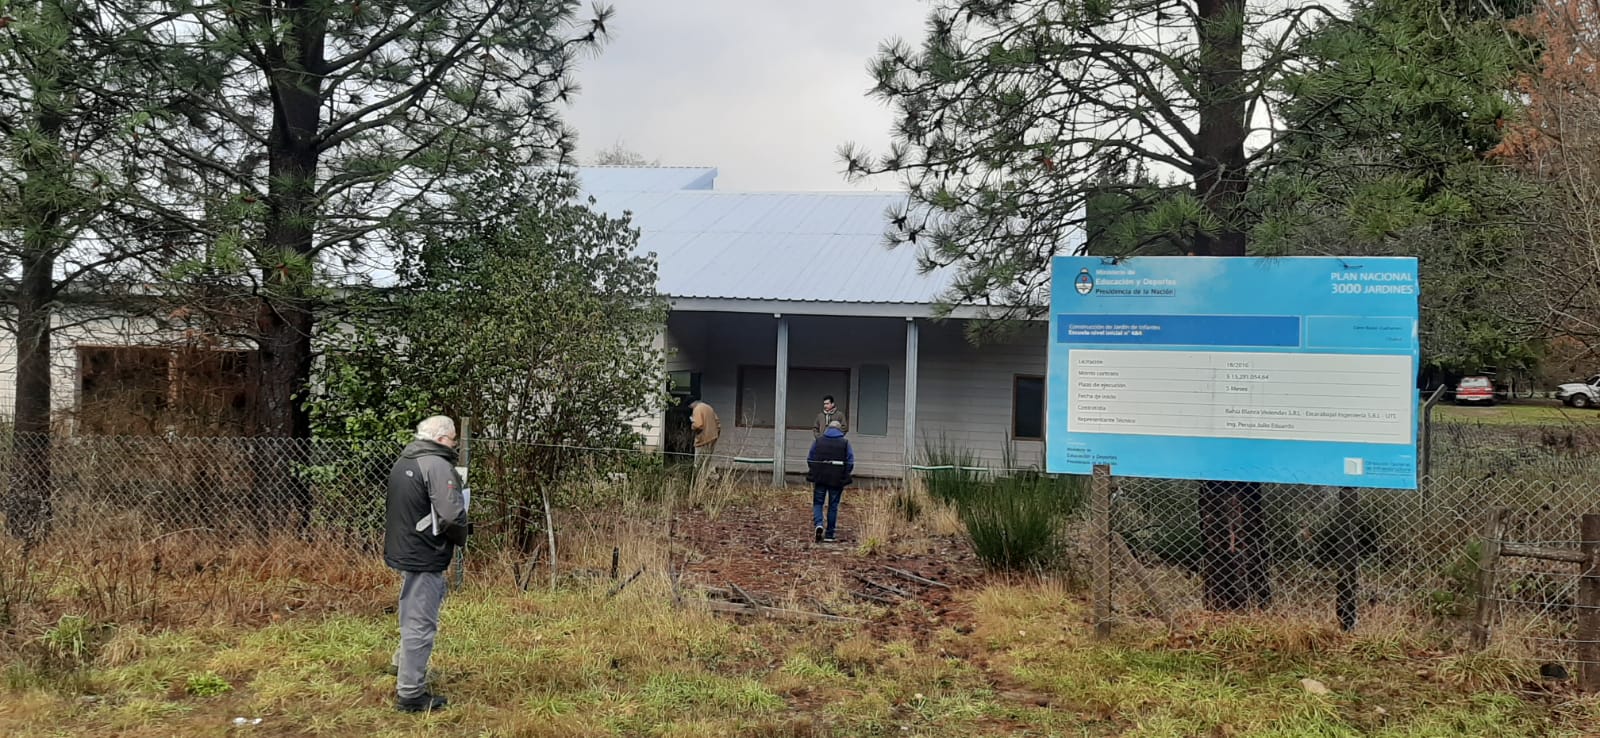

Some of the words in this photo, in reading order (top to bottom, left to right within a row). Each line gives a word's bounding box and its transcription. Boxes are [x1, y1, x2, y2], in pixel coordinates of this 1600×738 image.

[1331, 272, 1358, 281] PLAN
[1361, 272, 1413, 281] NACIONAL
[1144, 278, 1177, 287] Deportes
[1332, 283, 1361, 294] 3000
[1363, 285, 1414, 294] JARDINES
